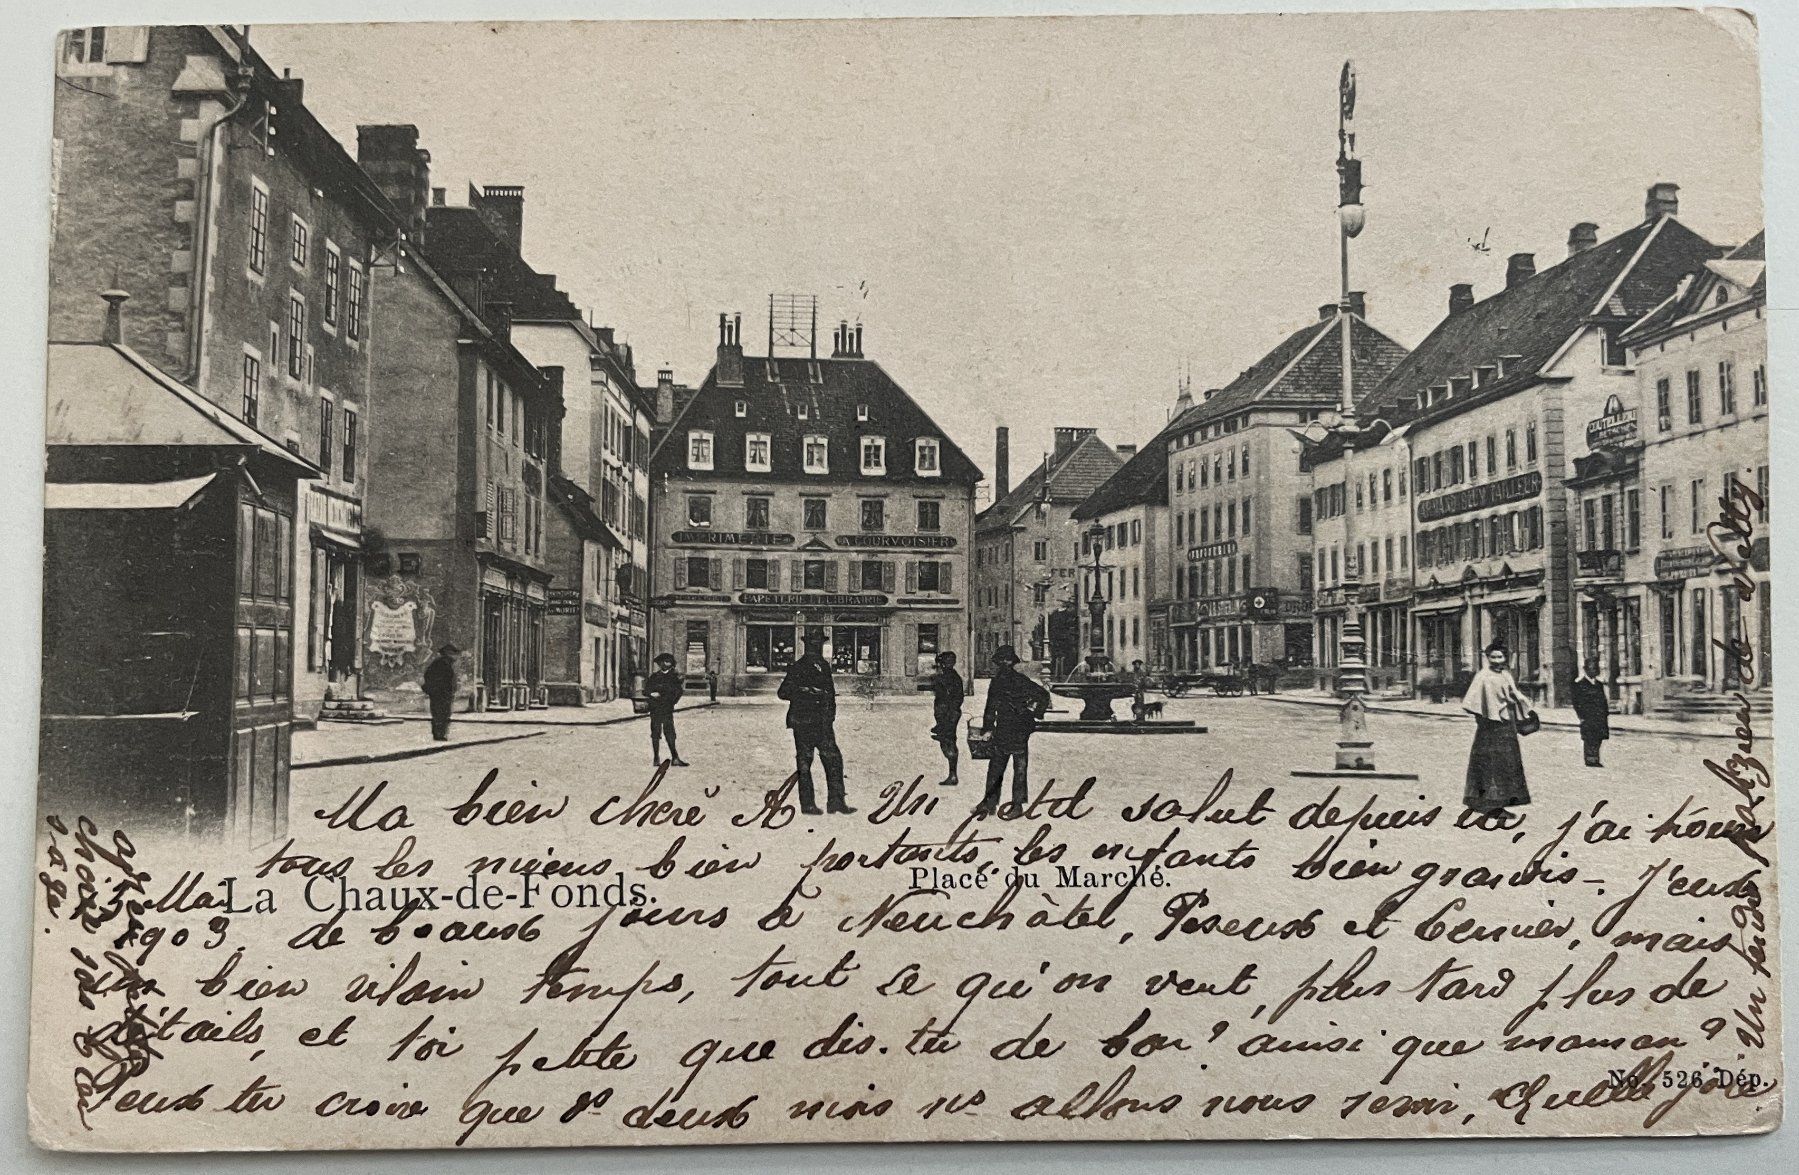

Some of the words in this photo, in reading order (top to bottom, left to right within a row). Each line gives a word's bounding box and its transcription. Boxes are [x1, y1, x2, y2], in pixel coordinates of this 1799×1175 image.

[314, 780, 414, 831] Ma
[443, 767, 569, 826] bien
[868, 774, 940, 824] Un
[950, 776, 1096, 851] petit
[1121, 767, 1276, 825] salut
[1288, 785, 1442, 862] depuis
[254, 838, 354, 880] tous
[372, 835, 434, 881] les
[635, 836, 762, 880] bien
[1014, 823, 1067, 866] les
[1291, 834, 1402, 881] bien
[288, 904, 346, 951] de
[1610, 916, 1733, 952] mais
[195, 952, 309, 1000] bien
[730, 944, 861, 998] tout
[1649, 956, 1729, 1004] de
[298, 1014, 357, 1047] et
[386, 1013, 465, 1062] toi
[670, 1038, 777, 1103] que
[989, 1012, 1068, 1061] de
[455, 1099, 546, 1147] que
[622, 1086, 759, 1131] deux
[1200, 1093, 1317, 1118] nous
